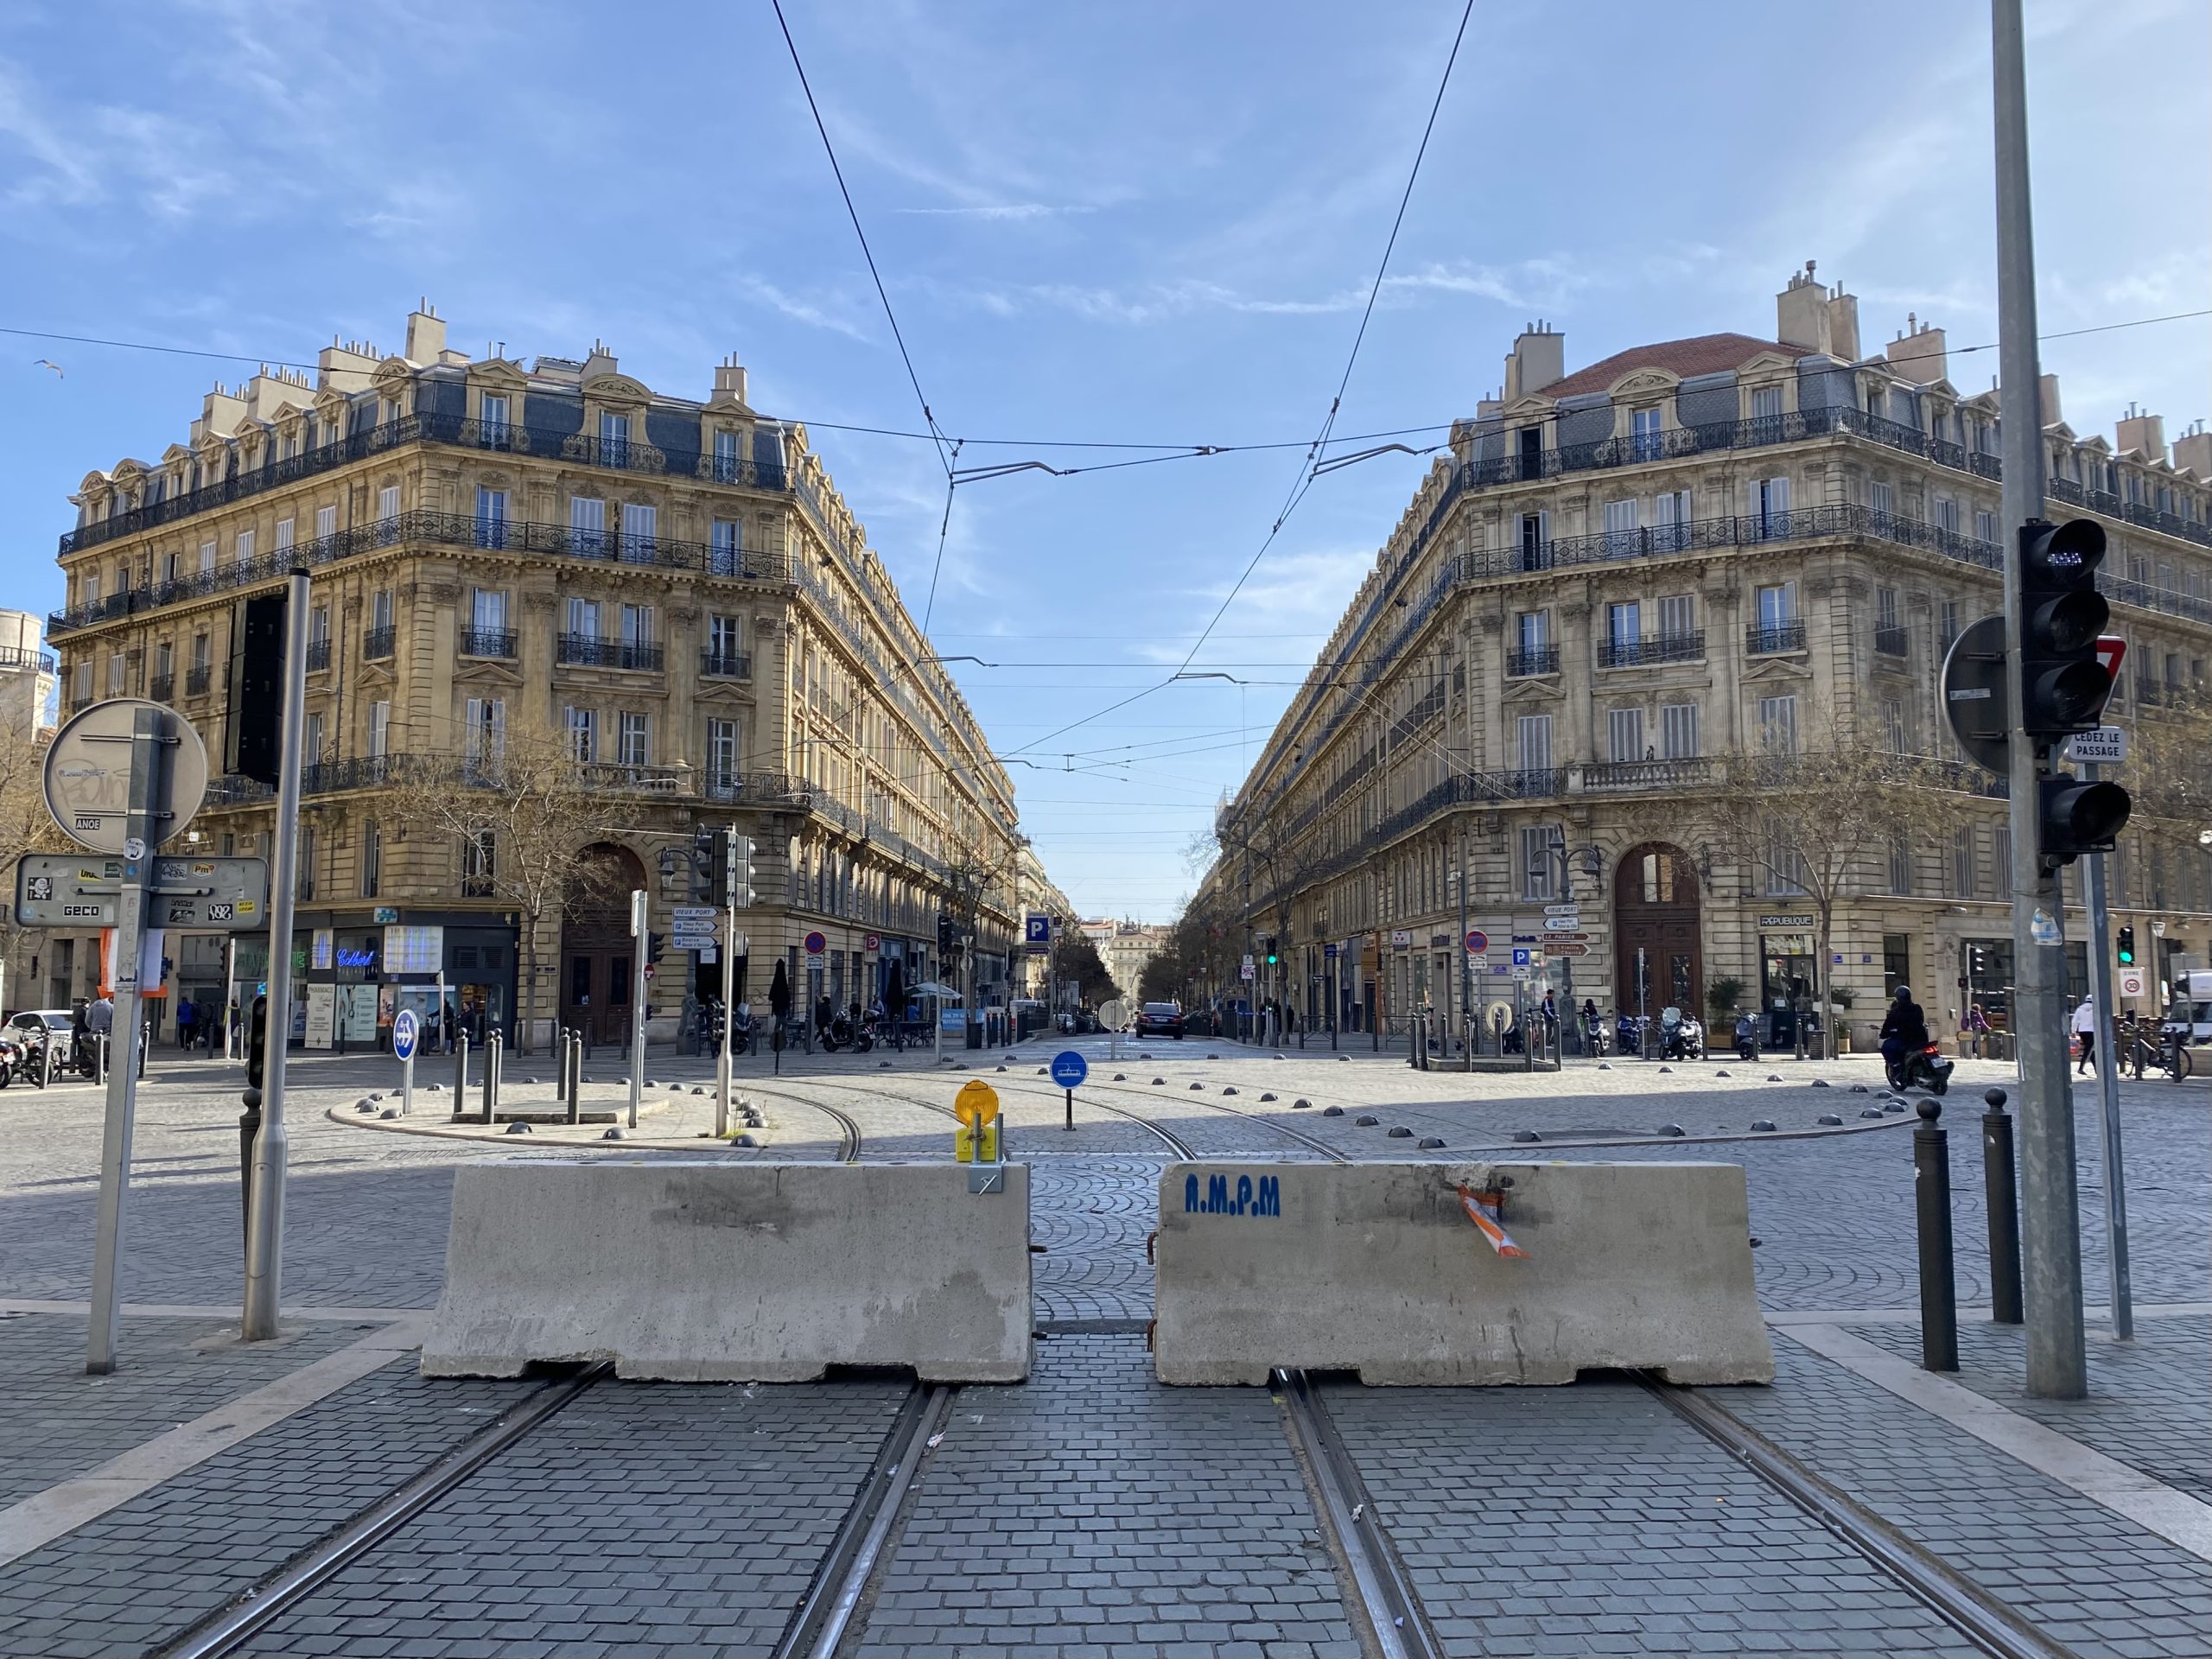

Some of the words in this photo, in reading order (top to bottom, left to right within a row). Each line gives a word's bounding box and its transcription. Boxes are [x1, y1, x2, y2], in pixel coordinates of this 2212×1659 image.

[2109, 734, 2120, 743] LE
[2076, 746, 2120, 757] PASSAGE
[1031, 921, 1043, 938] P
[1516, 951, 1526, 963] P
